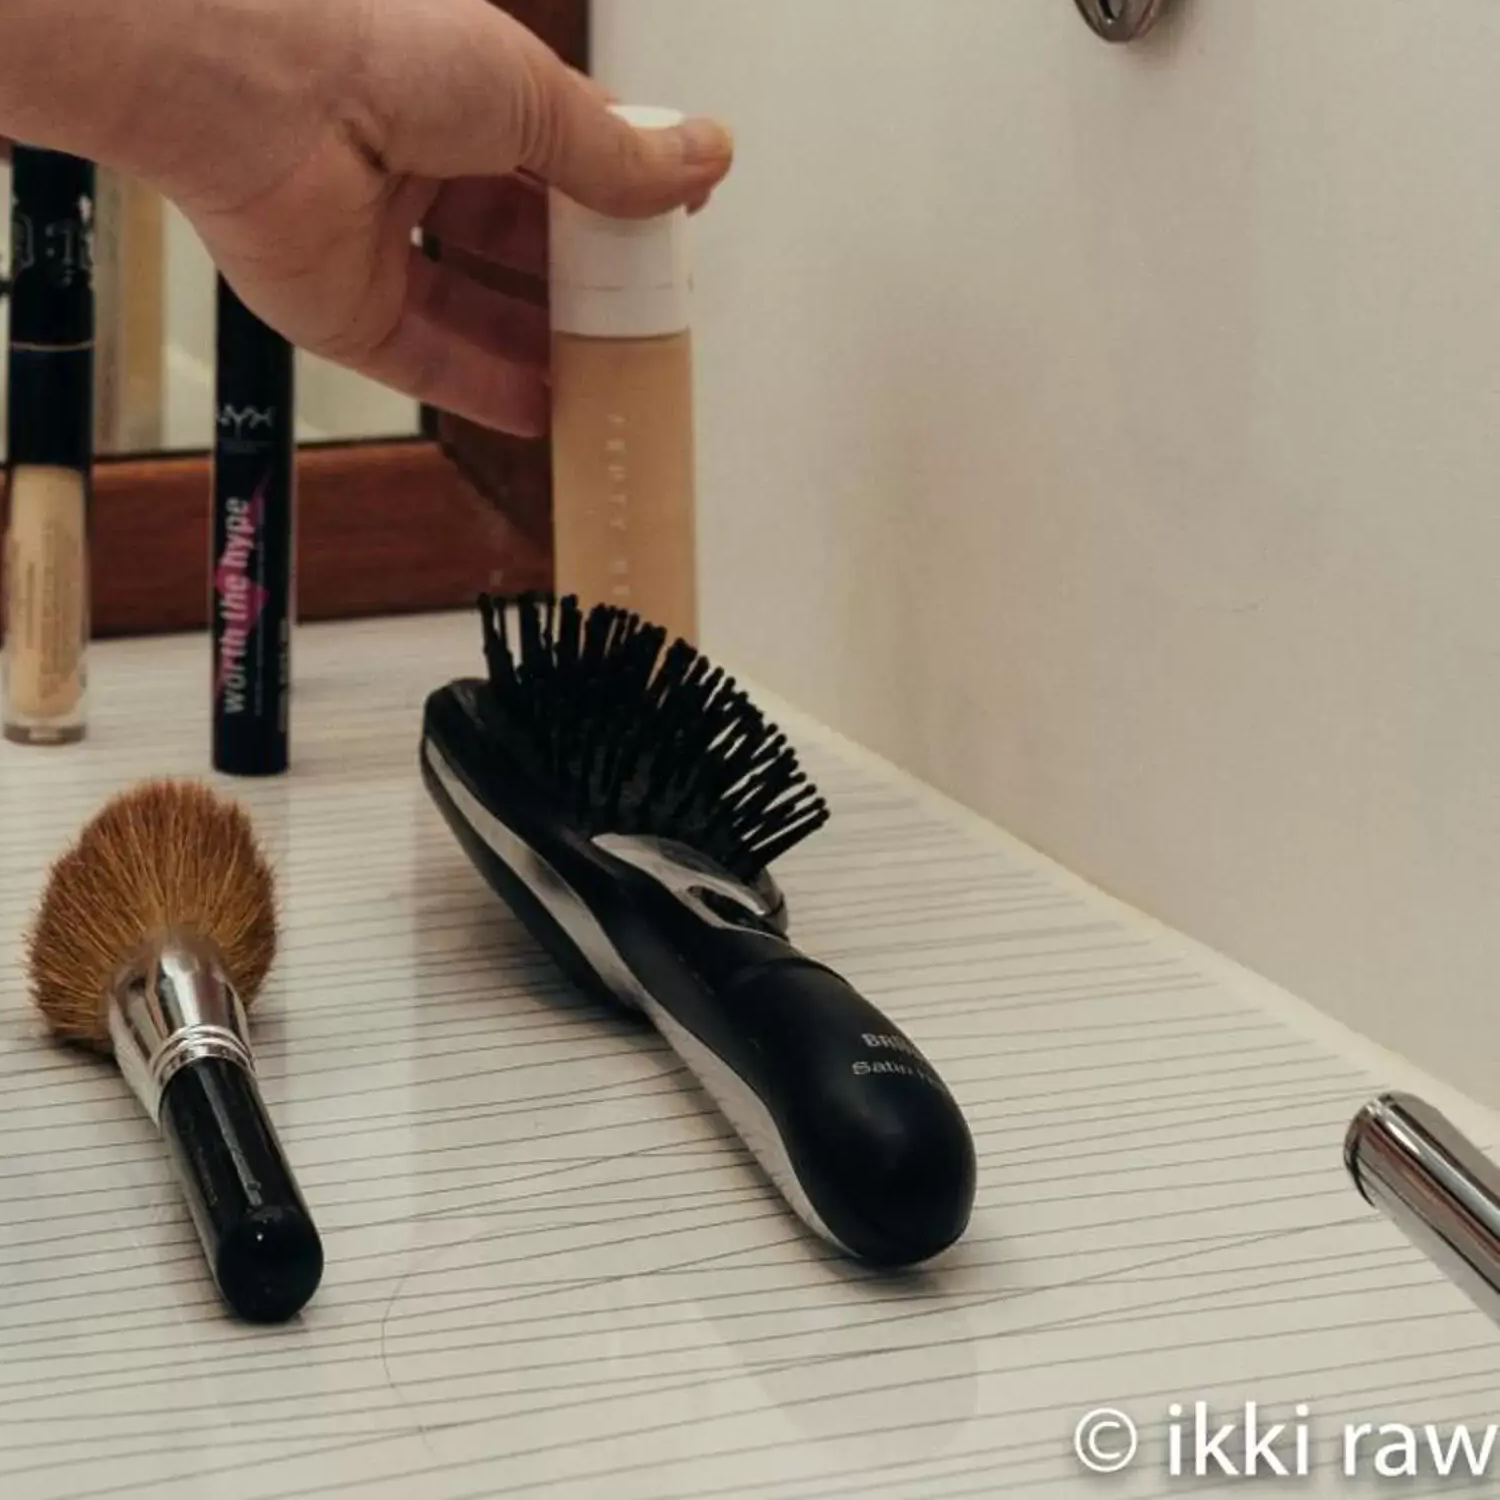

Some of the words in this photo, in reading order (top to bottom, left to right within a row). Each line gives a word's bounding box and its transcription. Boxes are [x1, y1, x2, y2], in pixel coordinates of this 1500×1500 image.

[218, 496, 255, 569] hype
[218, 575, 249, 622] the
[219, 629, 248, 715] worth
